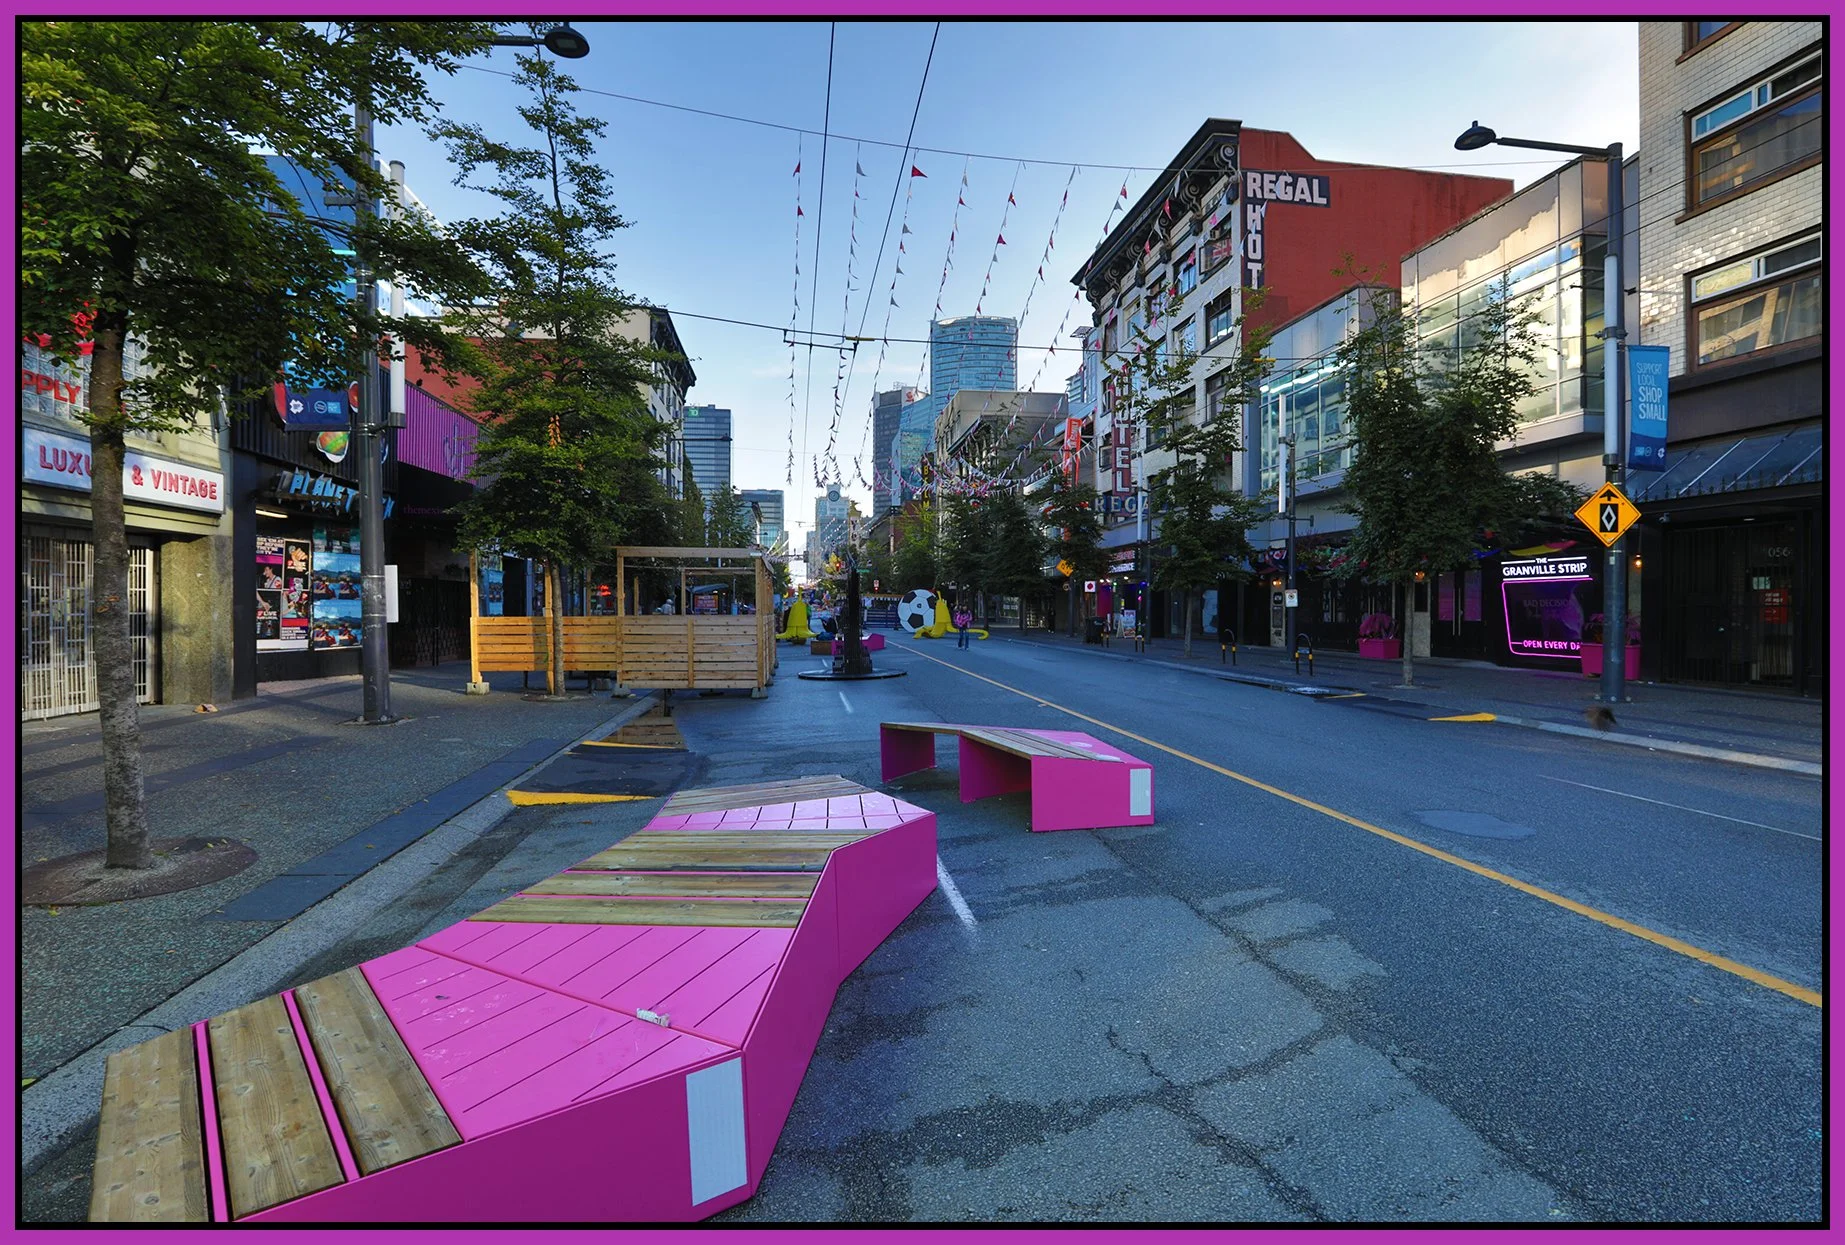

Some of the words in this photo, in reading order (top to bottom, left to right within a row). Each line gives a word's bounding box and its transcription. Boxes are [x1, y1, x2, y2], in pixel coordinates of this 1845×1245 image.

[1246, 171, 1327, 205] REGAL
[1636, 362, 1663, 376] SUPPORT
[1637, 374, 1656, 386] LOCAL
[1638, 386, 1663, 404] SHOP
[1638, 403, 1668, 422] SMALL
[131, 464, 143, 487] &
[151, 468, 218, 500] VINTAGE
[288, 467, 359, 513] PLANET
[1502, 564, 1557, 577] GRANVILLE
[1557, 562, 1588, 575] STRIP
[1523, 640, 1543, 649] OPEN
[1544, 640, 1568, 650] EVERY
